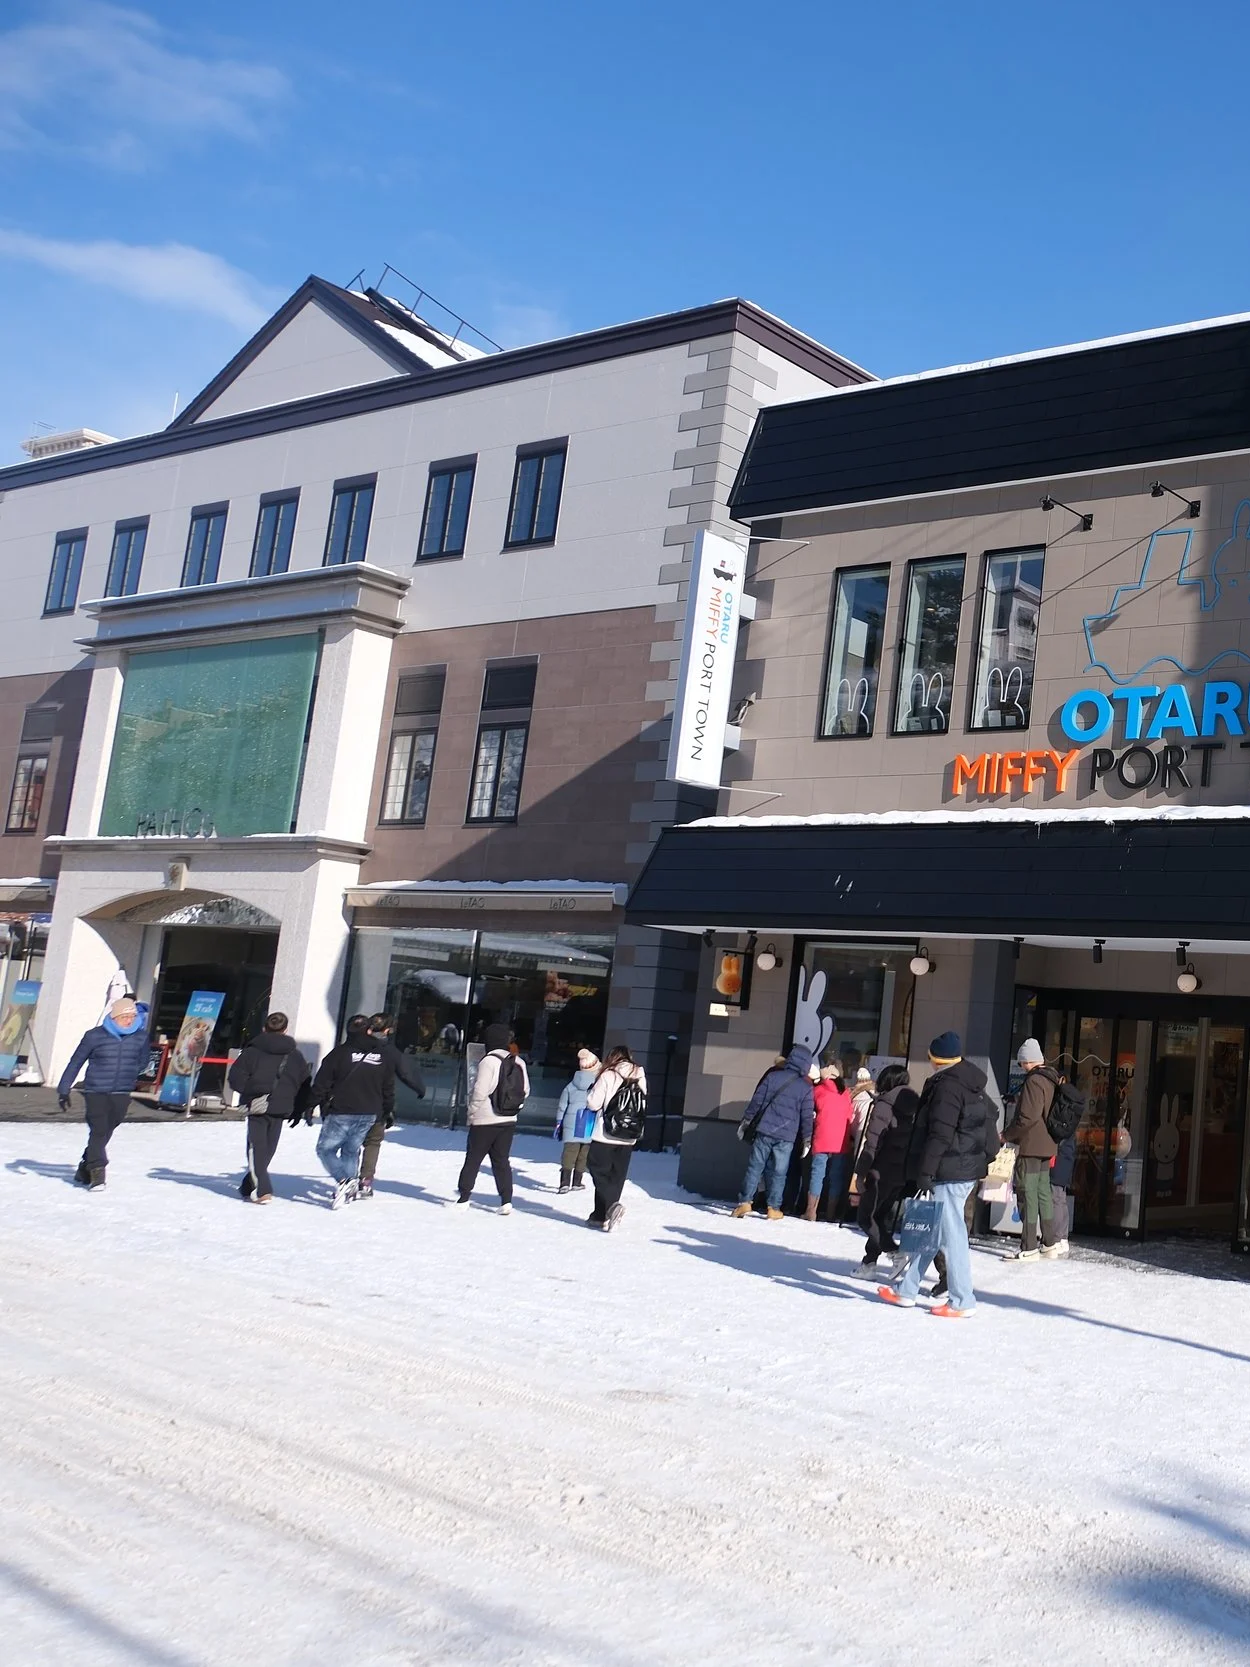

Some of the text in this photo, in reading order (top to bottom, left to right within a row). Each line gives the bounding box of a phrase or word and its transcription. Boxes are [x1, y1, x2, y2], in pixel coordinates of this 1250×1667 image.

[720, 592, 733, 644] OTARU
[690, 587, 722, 761] MIFFY PORT TOWN
[952, 748, 1081, 796] MIFFY
[1090, 742, 1226, 791] PORT
[1092, 1066, 1135, 1079] OTRU
